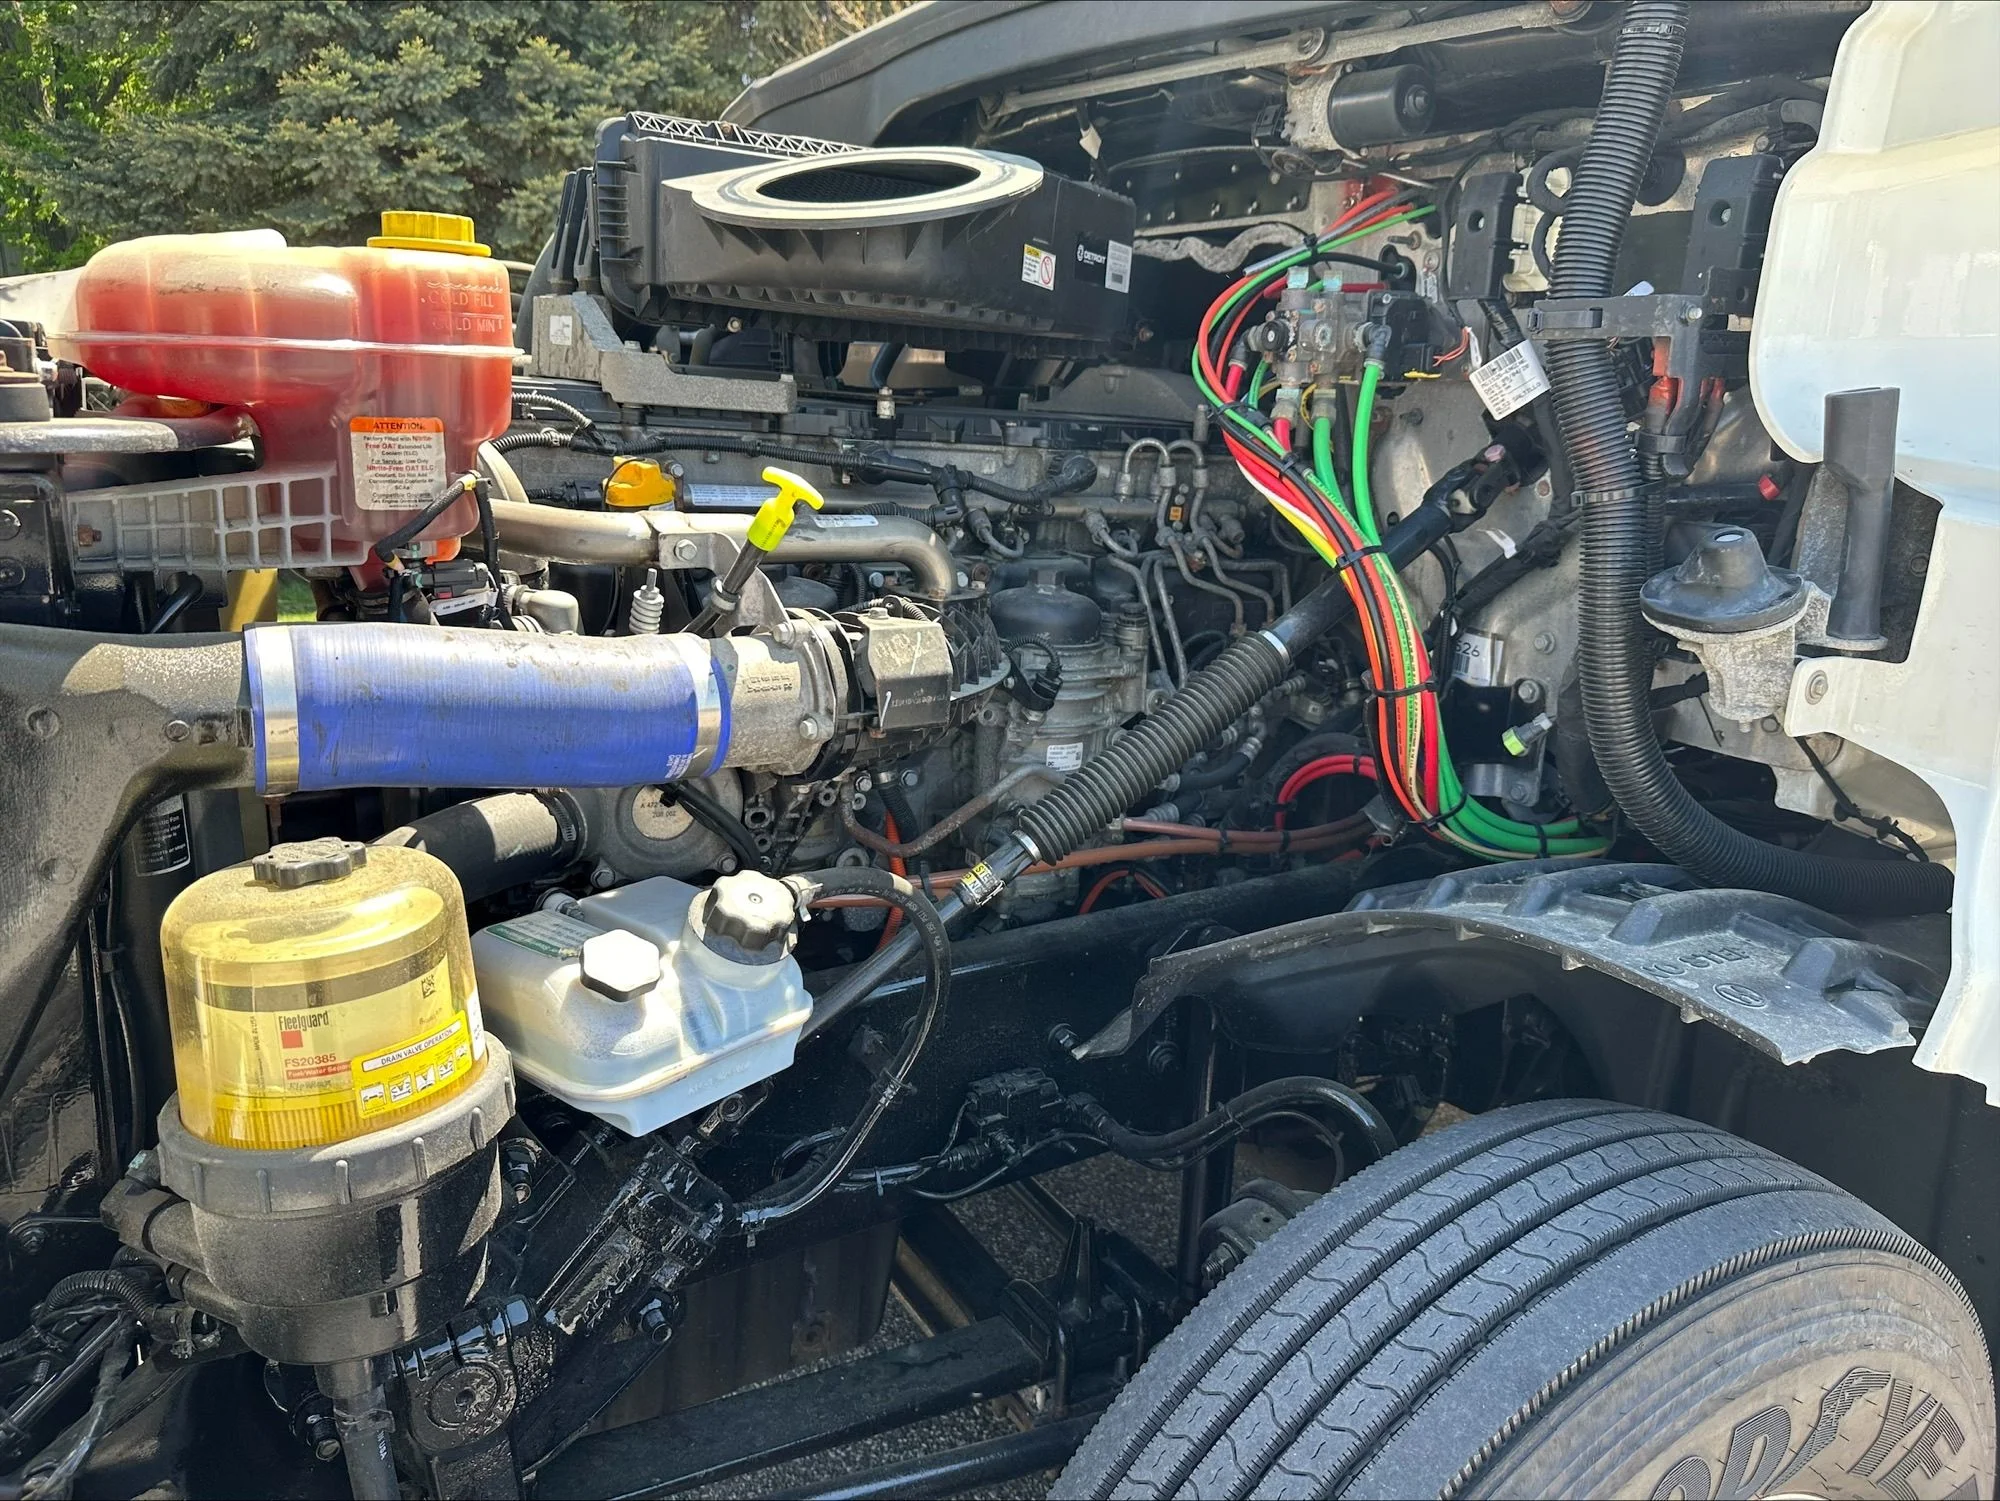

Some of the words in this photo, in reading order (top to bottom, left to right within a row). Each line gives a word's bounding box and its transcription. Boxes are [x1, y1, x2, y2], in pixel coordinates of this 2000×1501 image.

[1084, 250, 1106, 264] DETROIT
[428, 290, 469, 306] COLD
[474, 293, 494, 308] FILL
[373, 422, 424, 430] ATTENTION
[279, 1010, 330, 1032] Fleetguard
[380, 1052, 403, 1065] DRAIN
[403, 1044, 423, 1057] VALVE
[423, 1028, 454, 1050] OPERATION
[284, 1053, 337, 1068] FS20385
[287, 1067, 327, 1077] Fuel/Water
[379, 1440, 388, 1461] USA
